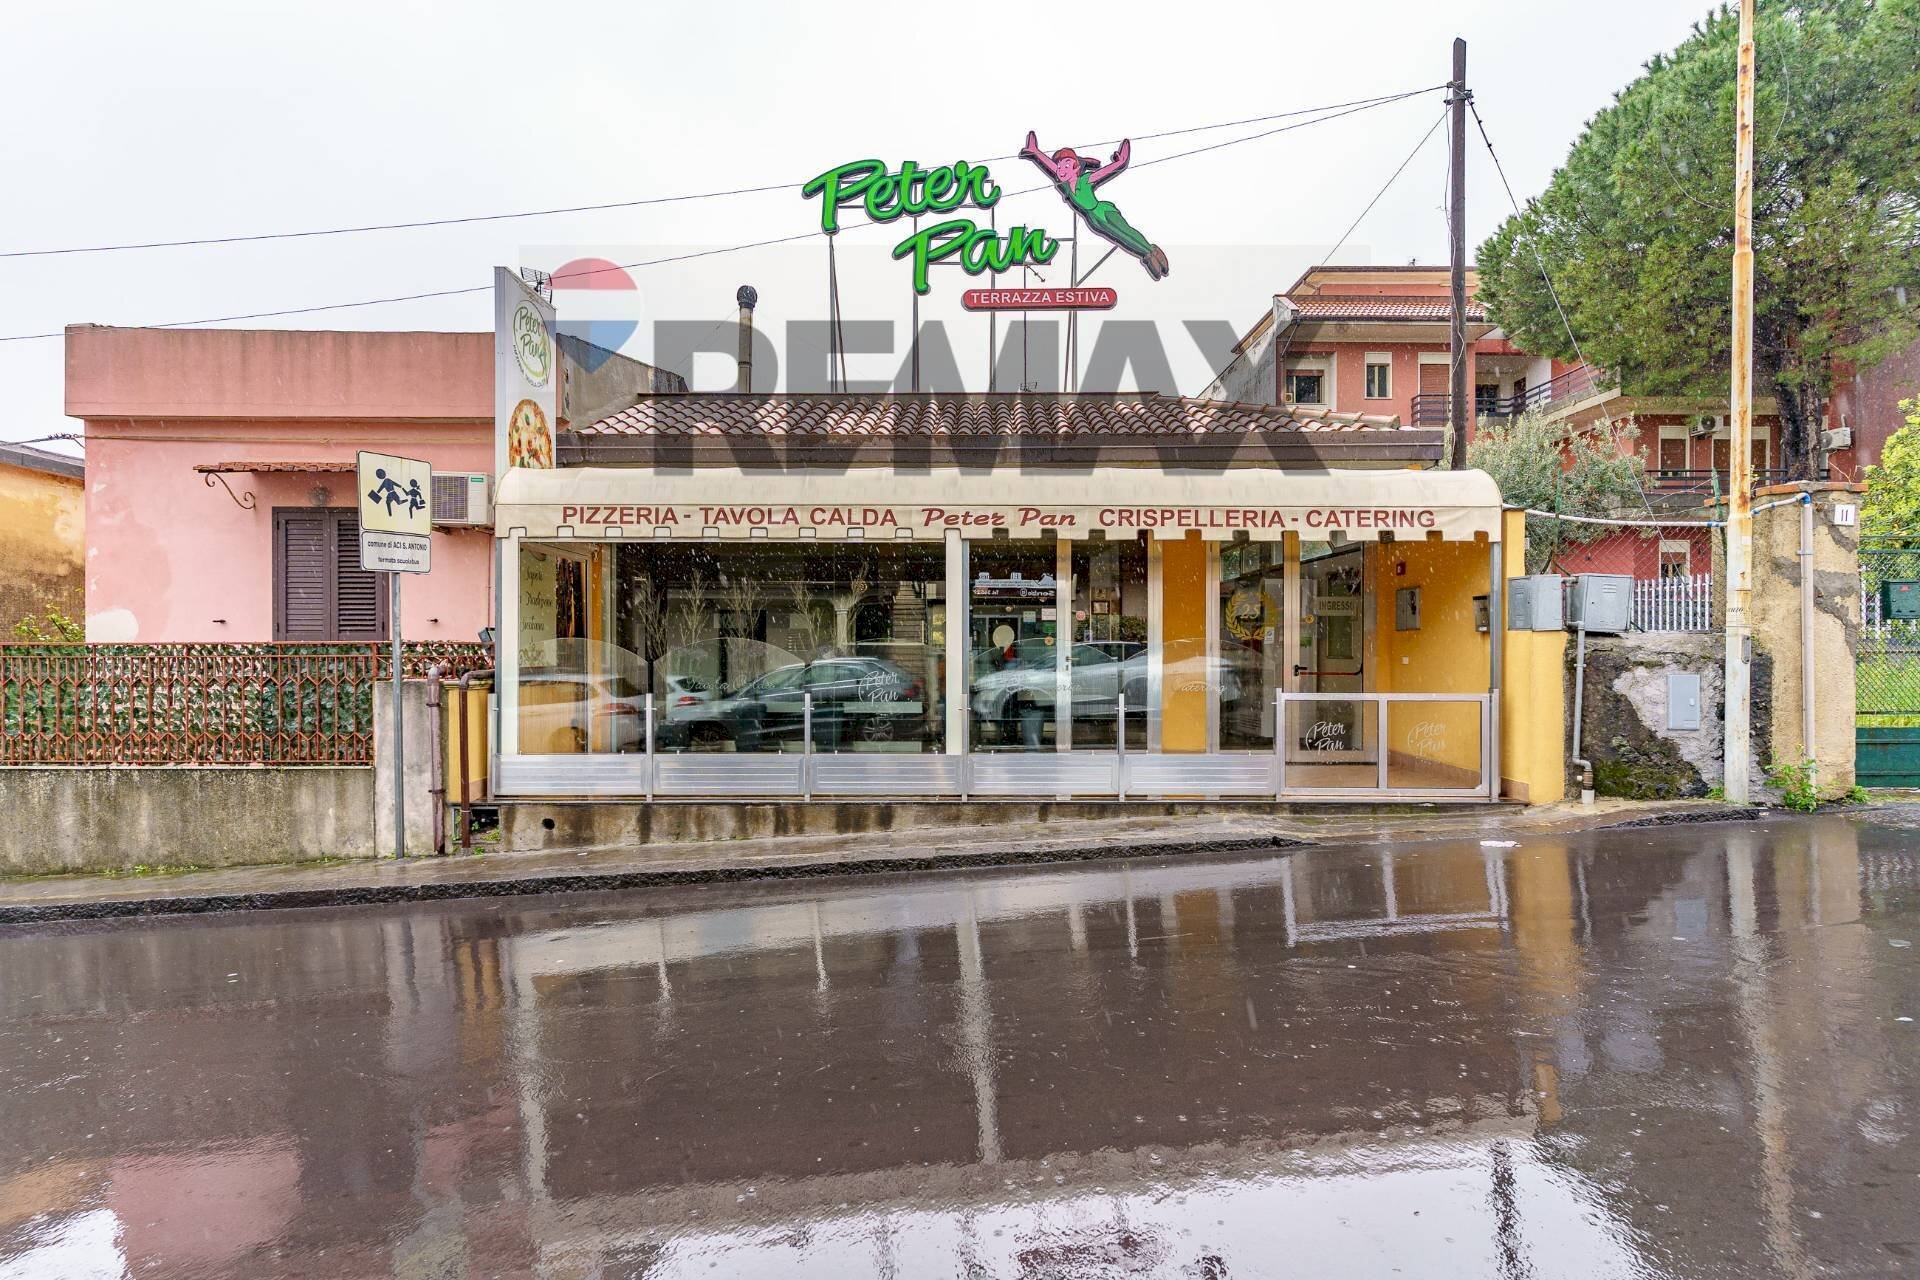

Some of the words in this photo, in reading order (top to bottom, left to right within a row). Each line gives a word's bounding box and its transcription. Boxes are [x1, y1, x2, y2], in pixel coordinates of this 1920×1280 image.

[802, 159, 1001, 235] Peter
[892, 219, 1059, 295] Pan
[971, 291, 1052, 304] TERRAZZA
[1055, 291, 1110, 303] ESTIVA
[515, 306, 541, 337] Peter
[520, 333, 543, 358] Pan
[562, 506, 679, 525] PIZZERIA
[700, 507, 801, 526] TAVOLA
[810, 507, 898, 527] CALDA
[921, 508, 1005, 527] Peter
[1018, 507, 1077, 527] Pan
[1099, 508, 1286, 528] CRISPELLERIA
[1305, 509, 1436, 528] CATERING
[393, 541, 402, 549] ACI
[408, 543, 428, 551] ANTONIO
[859, 670, 900, 690] Peter
[867, 687, 899, 706] Pan
[1306, 721, 1346, 740] Peter
[1314, 737, 1345, 756] Pan
